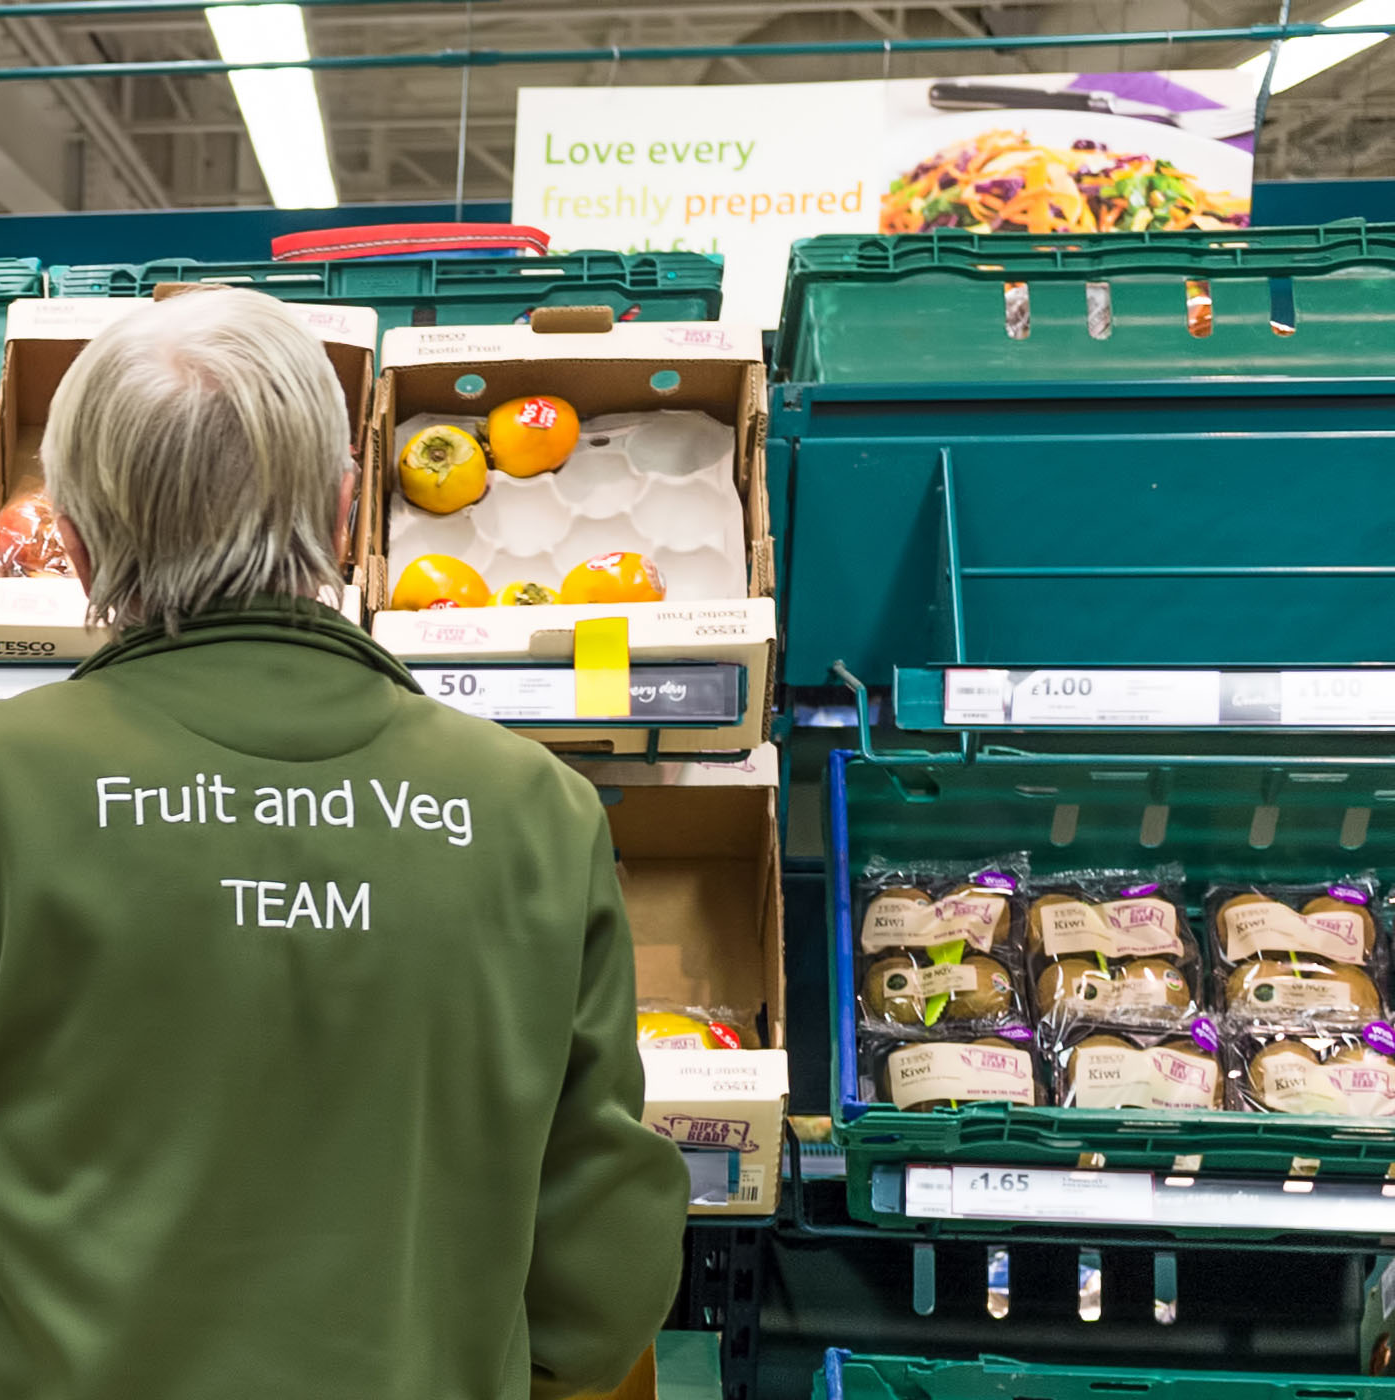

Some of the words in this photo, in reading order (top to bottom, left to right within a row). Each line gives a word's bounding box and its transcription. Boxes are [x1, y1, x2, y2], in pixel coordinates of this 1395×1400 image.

[545, 133, 636, 165] Love
[648, 139, 756, 171] every
[541, 185, 673, 225] freshly
[684, 181, 864, 224] prepared
[418, 346, 463, 355] Exotic
[467, 345, 502, 354] Fruit
[695, 625, 748, 636] TESCO
[1031, 678, 1093, 697] £1.00
[97, 775, 236, 827] Fruit
[254, 779, 356, 828] and
[370, 779, 473, 846] Veg
[221, 879, 371, 931] TEAM
[874, 916, 905, 928] Kiwi
[1054, 919, 1086, 930] Kiwi
[1235, 919, 1266, 935] Kiwi
[900, 1065, 932, 1079] Kiwi
[1088, 1068, 1121, 1081] Kiwi
[1274, 1077, 1307, 1092] Kiwi
[690, 1121, 719, 1133] RIPE
[719, 1122, 730, 1134] &
[686, 1130, 730, 1143] READY
[970, 1172, 1030, 1192] £1.65
